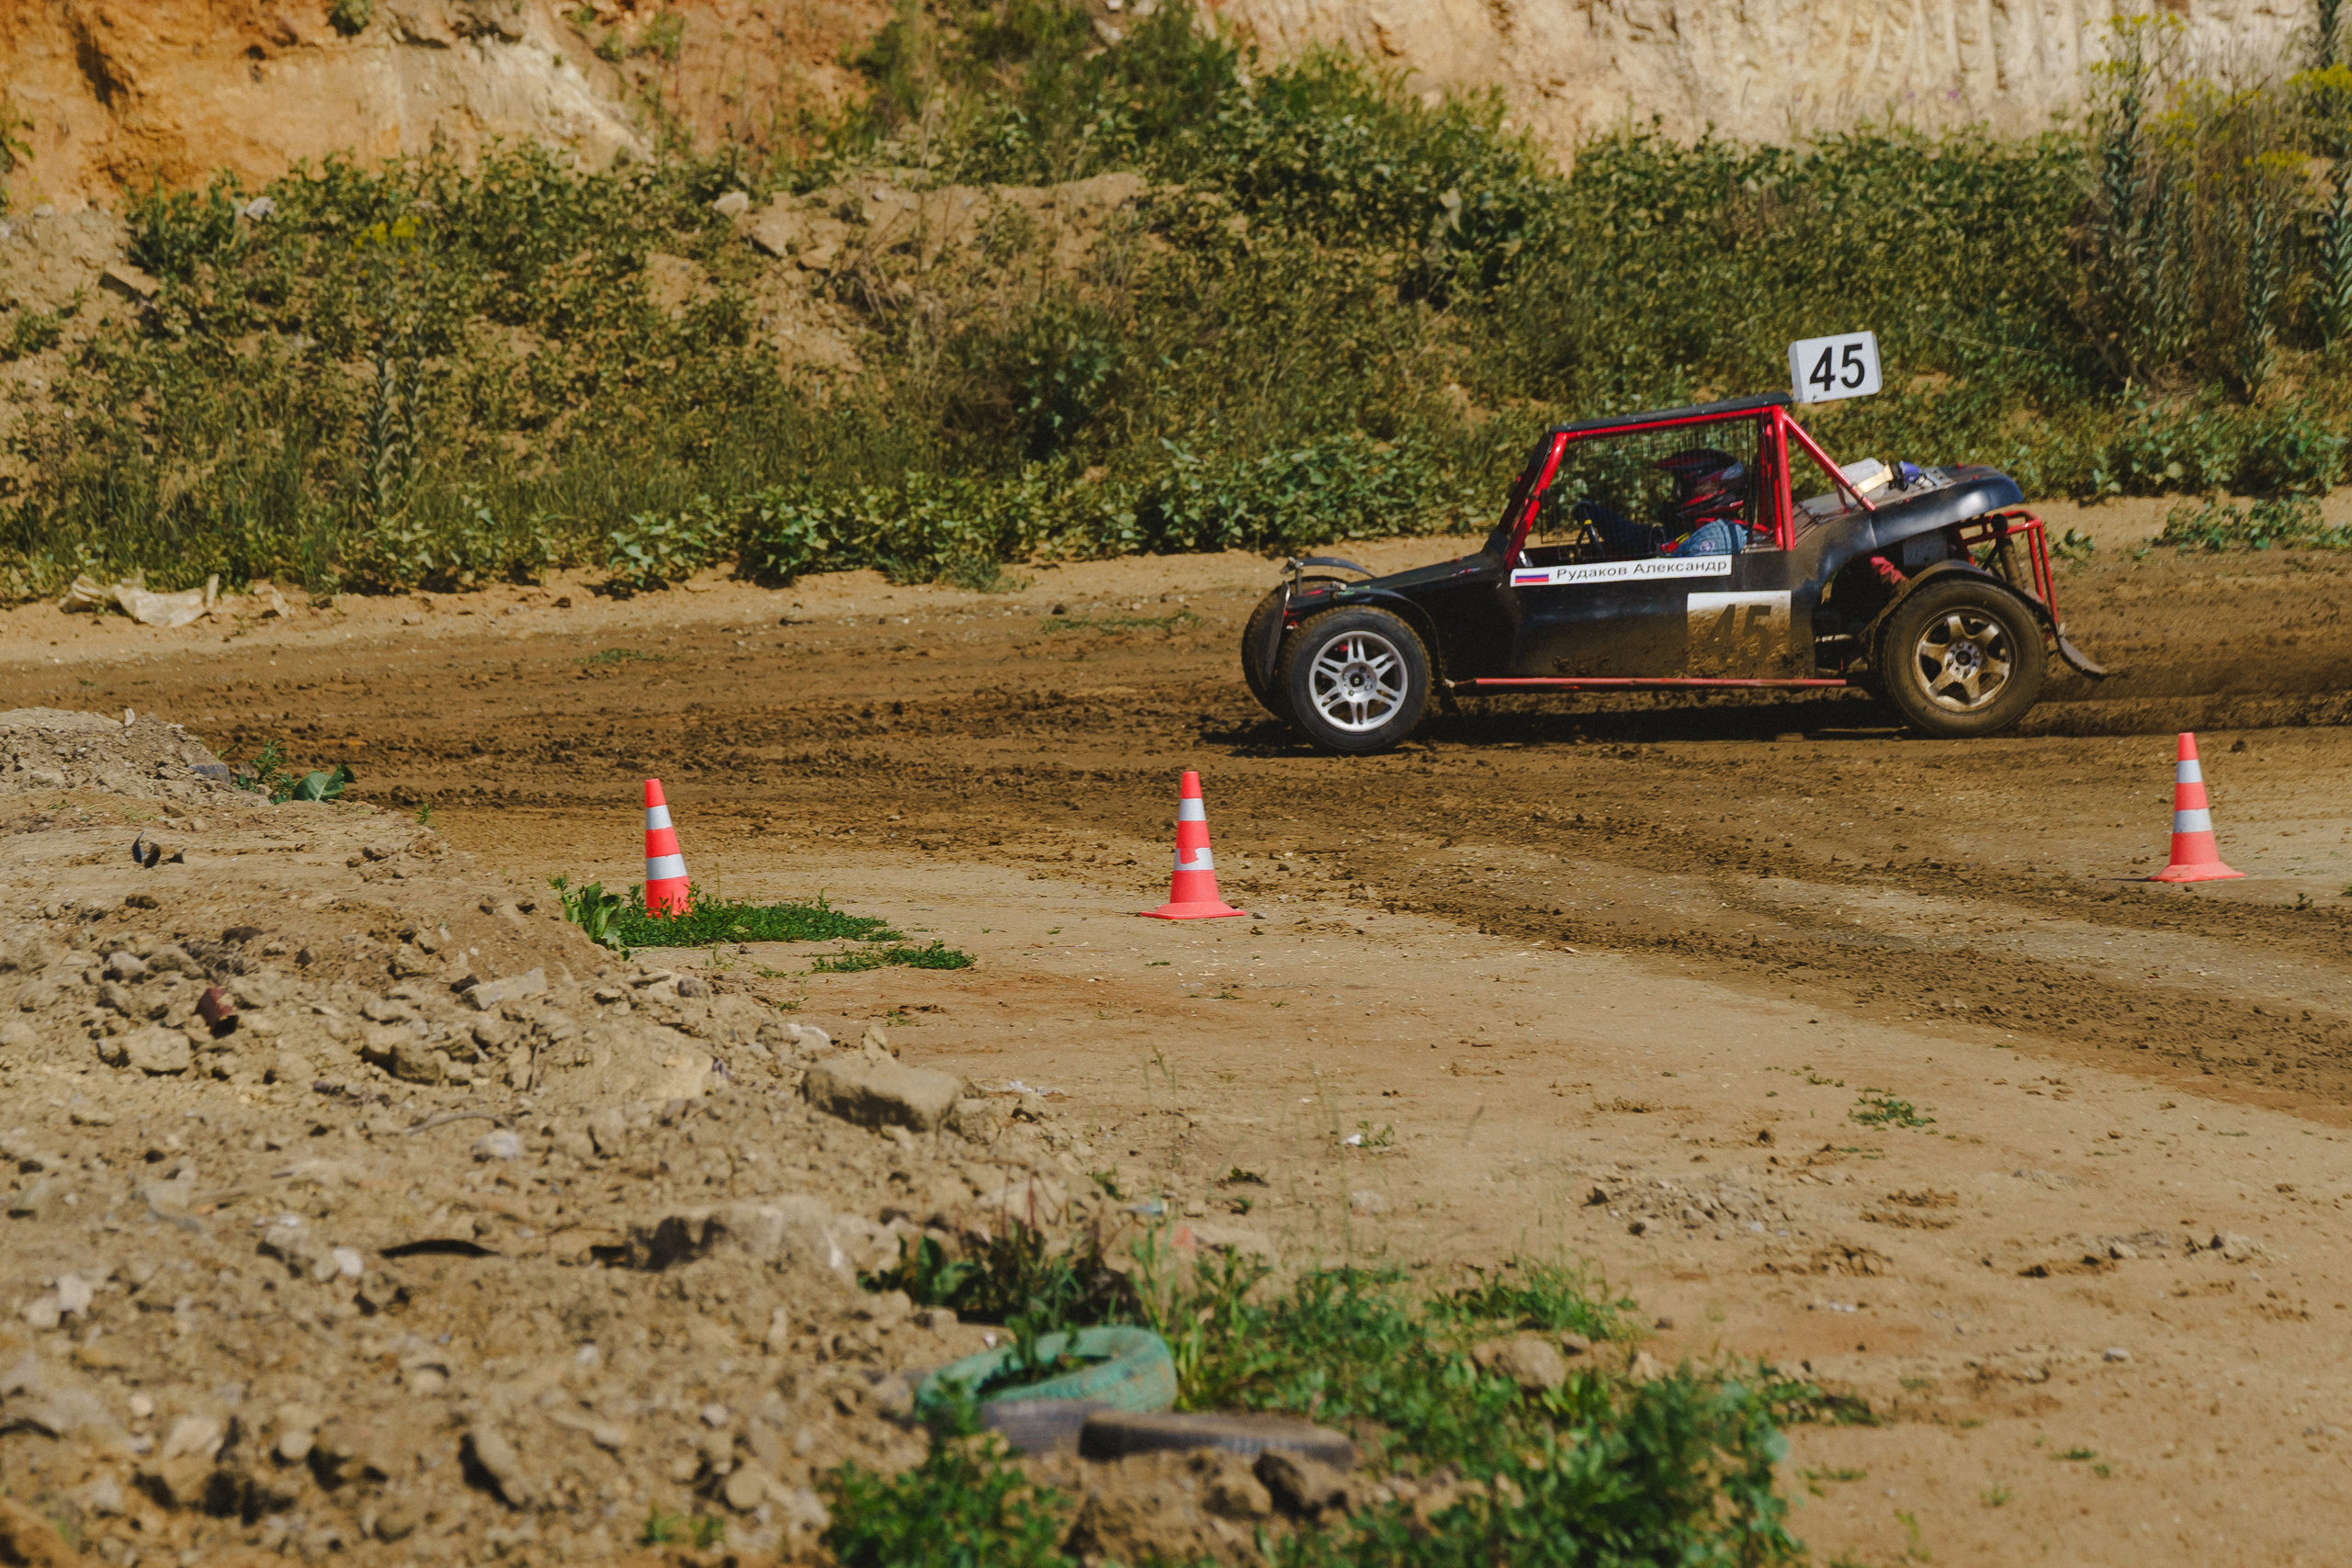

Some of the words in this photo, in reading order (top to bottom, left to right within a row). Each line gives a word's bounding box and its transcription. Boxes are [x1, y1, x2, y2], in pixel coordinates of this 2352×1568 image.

[1809, 343, 1865, 392] 45
[1557, 567, 1627, 581] Рудаков
[1634, 560, 1727, 574] Александр
[1706, 604, 1771, 664] 45
